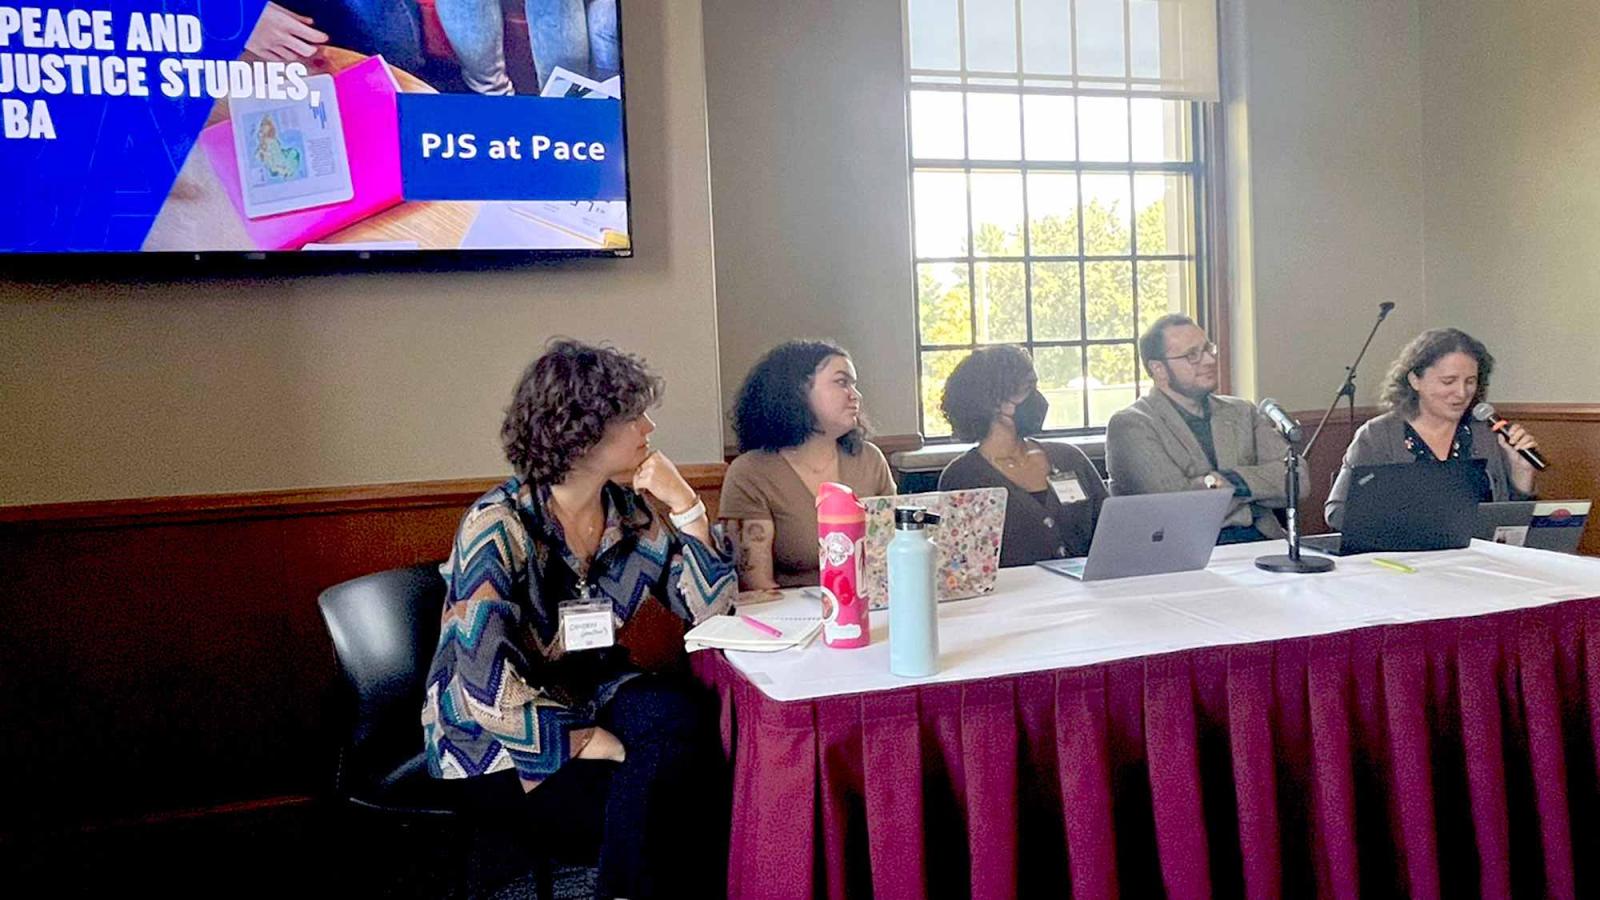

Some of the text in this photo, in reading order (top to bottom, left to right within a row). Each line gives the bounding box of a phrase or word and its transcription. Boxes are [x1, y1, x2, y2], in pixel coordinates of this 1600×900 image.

[0, 6, 202, 54] PEACE AND
[0, 52, 321, 107] JUSTICE STUDIES,
[2, 98, 57, 140] BA
[421, 132, 607, 161] PJS at Pace
